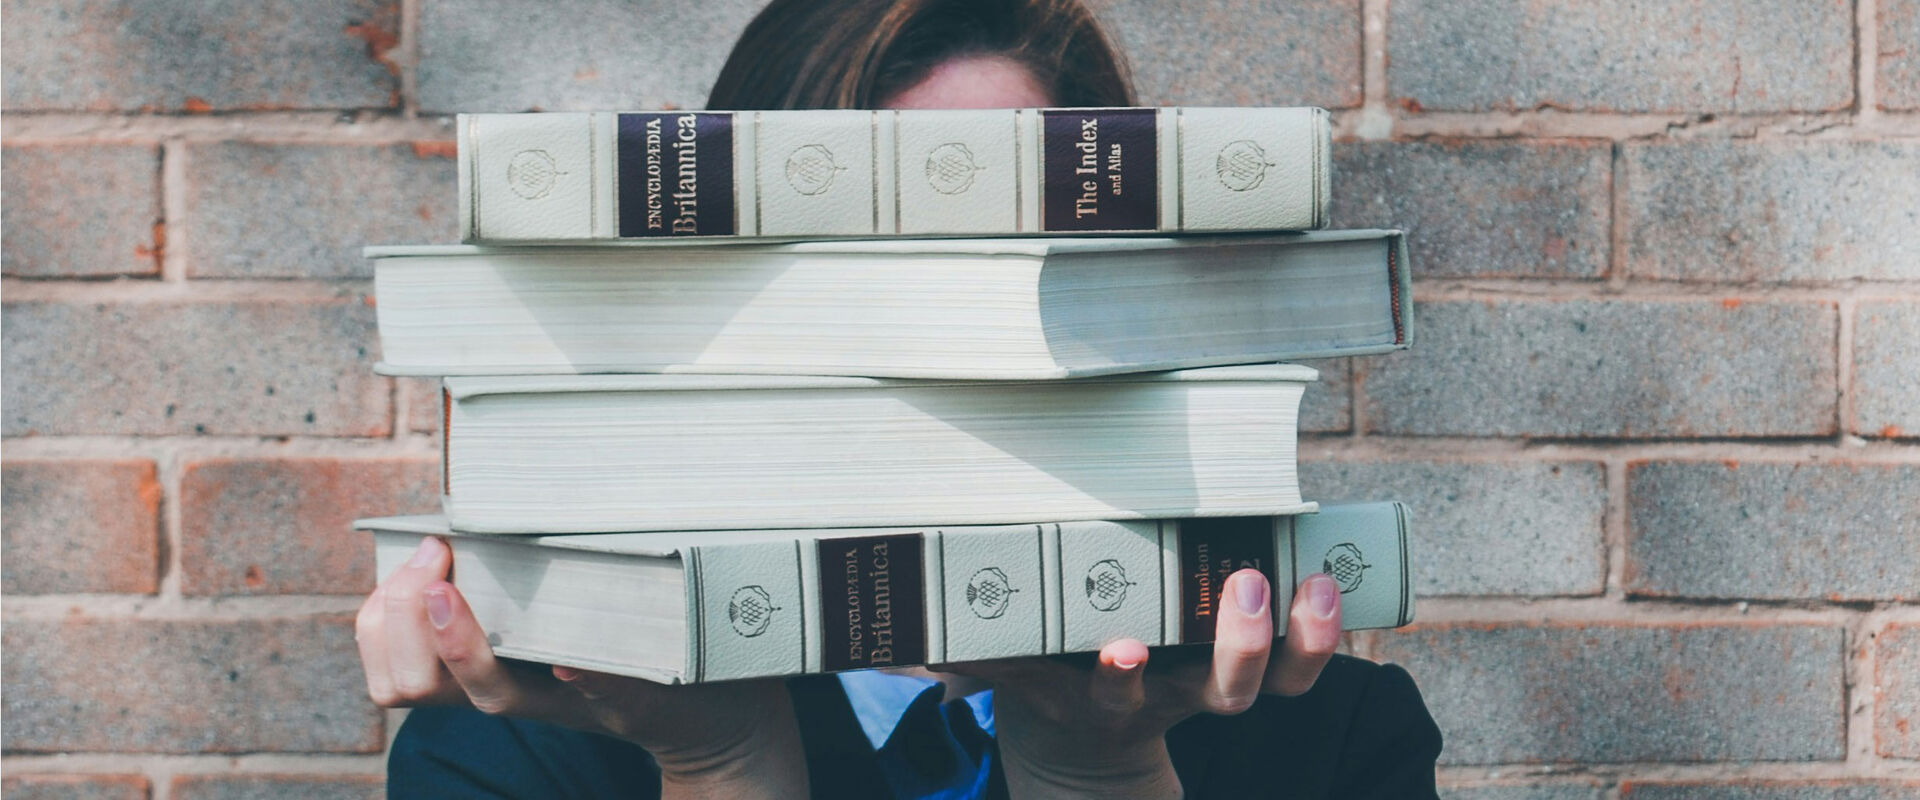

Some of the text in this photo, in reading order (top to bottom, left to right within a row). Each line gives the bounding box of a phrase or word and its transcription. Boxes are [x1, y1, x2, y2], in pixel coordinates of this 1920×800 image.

[646, 118, 662, 229] ENCYCLOPÆDIA
[672, 113, 697, 234] Britannica
[1075, 118, 1098, 219] The Index
[1108, 143, 1122, 195] and Atlas
[870, 541, 893, 664] Britannica
[1194, 543, 1210, 620] Timoleon
